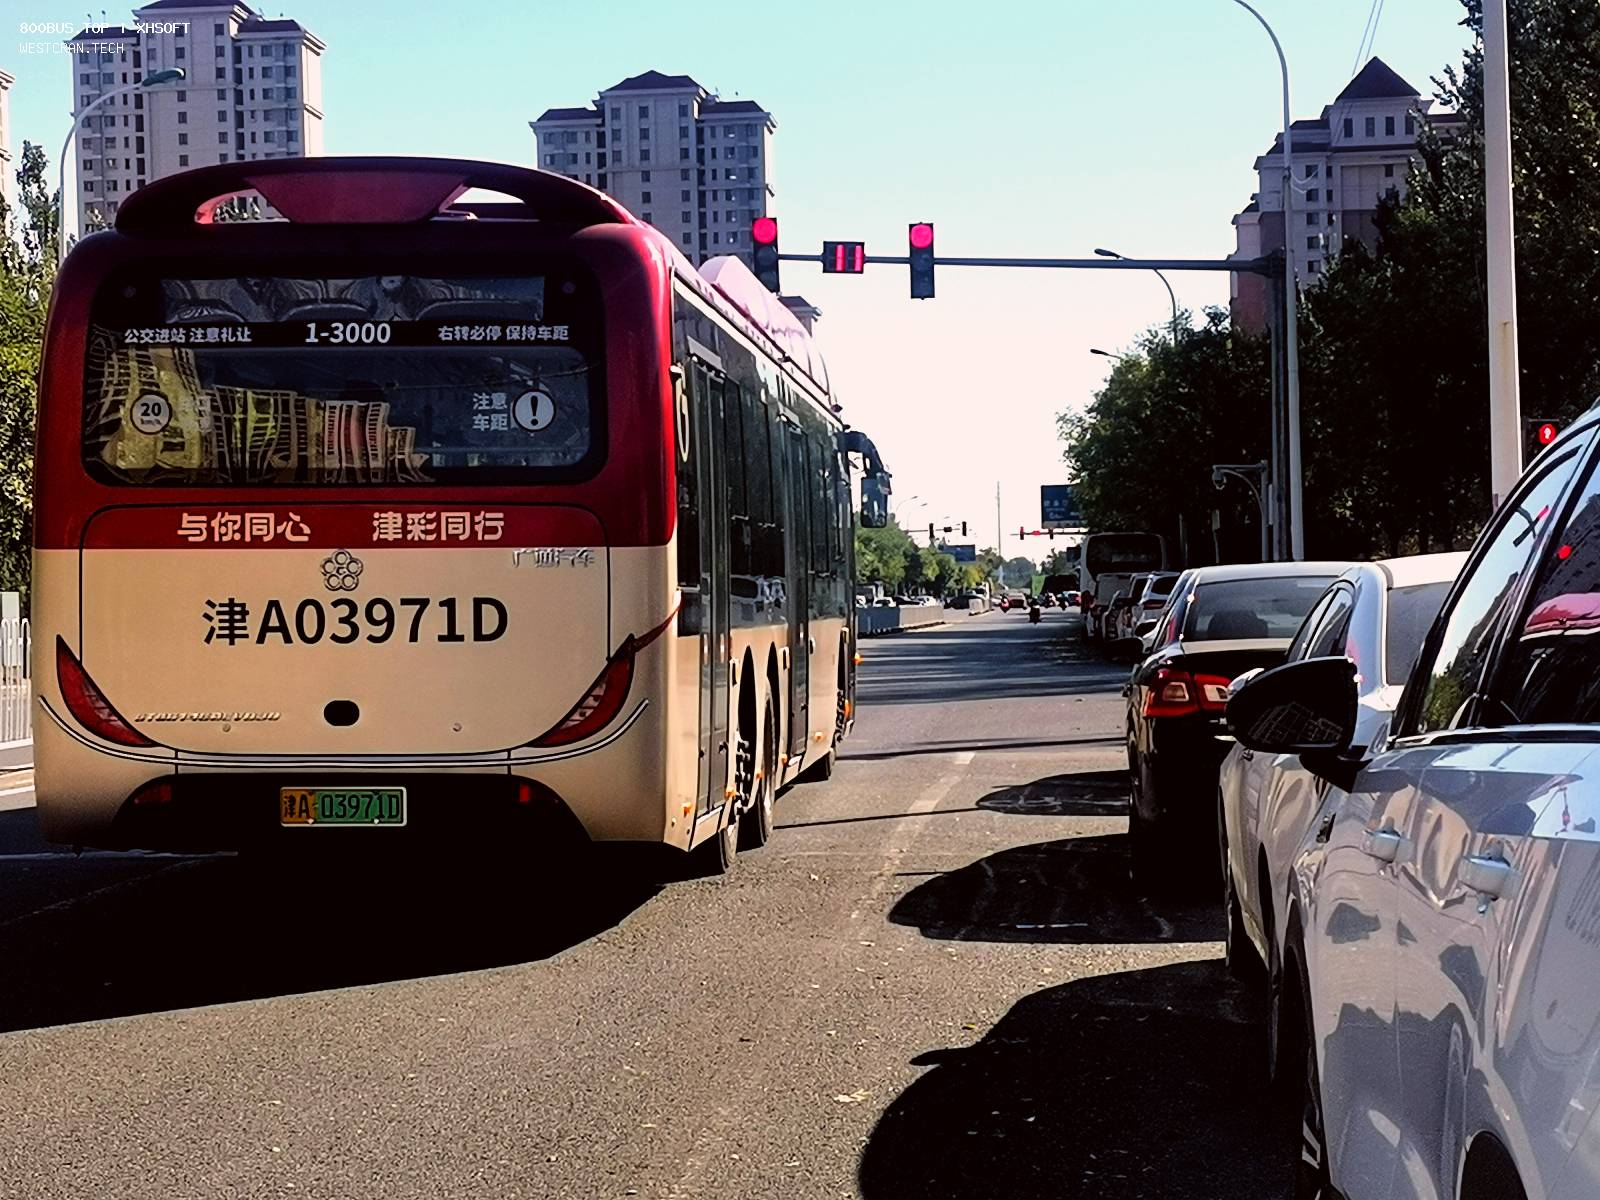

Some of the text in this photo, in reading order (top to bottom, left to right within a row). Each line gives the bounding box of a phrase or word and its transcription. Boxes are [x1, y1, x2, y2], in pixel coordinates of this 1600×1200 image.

[124, 322, 569, 344] 公交进站 注意礼让 1-3000 右转必停 保持车距
[140, 402, 162, 417] 20
[472, 392, 508, 410] 注意
[472, 413, 508, 431] 车距
[177, 511, 505, 542] 与你同心 津彩同行
[202, 597, 508, 646] 津A03971D
